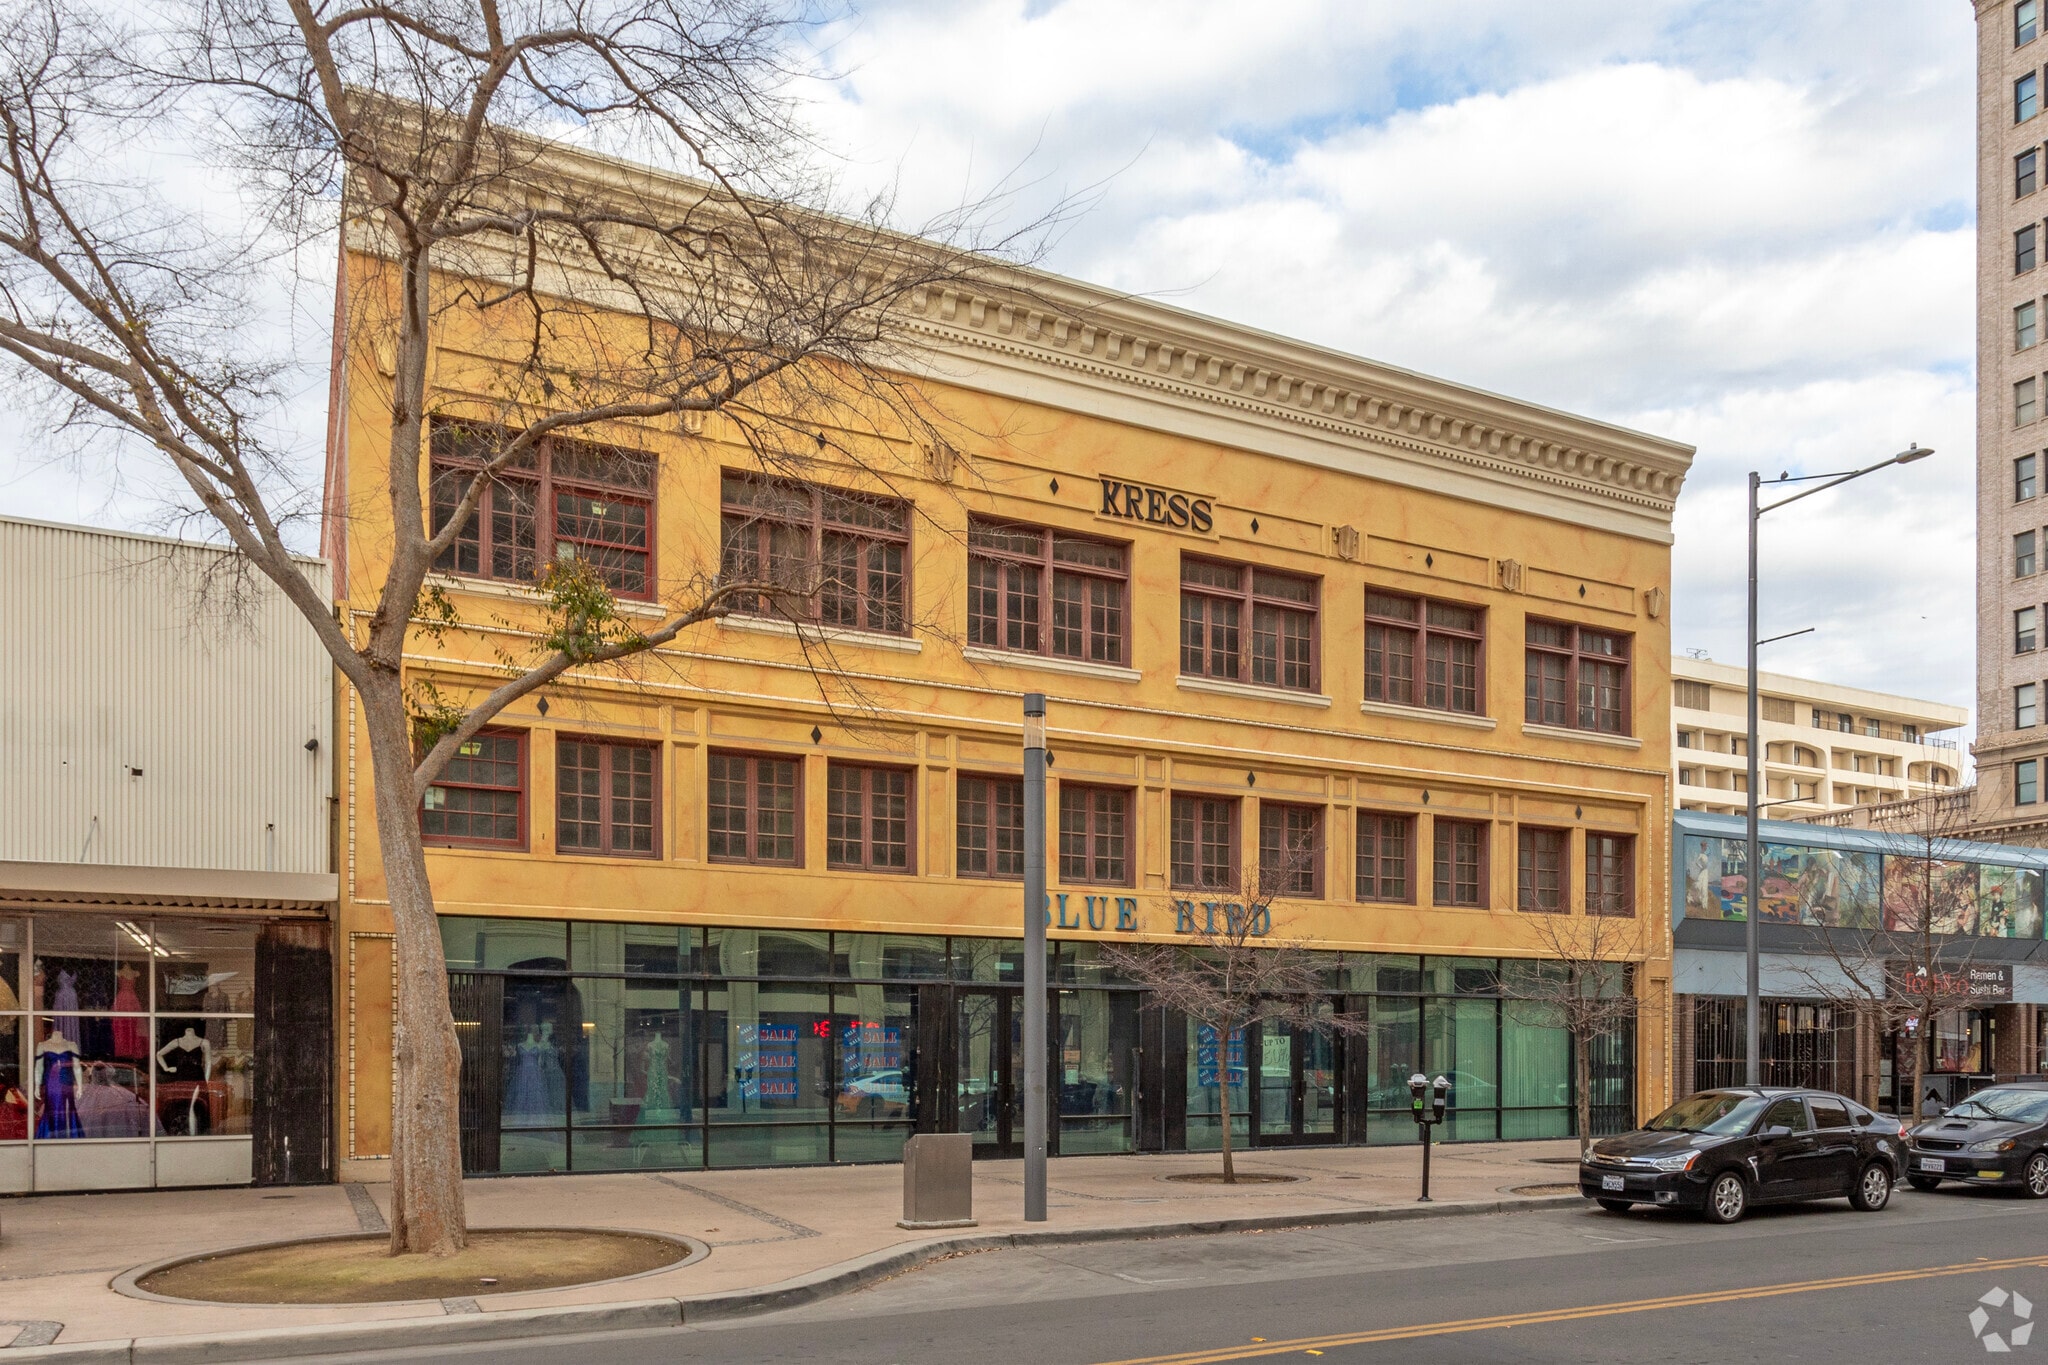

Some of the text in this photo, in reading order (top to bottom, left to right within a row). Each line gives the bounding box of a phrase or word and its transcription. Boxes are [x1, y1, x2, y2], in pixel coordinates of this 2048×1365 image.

[1100, 479, 1213, 532] KRESS
[1046, 893, 1271, 937] LUE BIRD
[1970, 969, 2004, 981] Ramen &
[1992, 984, 2006, 995] Bar
[760, 1029, 797, 1041] SALE
[863, 1032, 897, 1044] SALE
[1214, 1030, 1242, 1041] SLE
[1264, 1037, 1286, 1047] UP TO
[759, 1055, 796, 1068] SALE
[863, 1056, 898, 1068] SALE
[1214, 1051, 1242, 1062] SLE
[1214, 1072, 1241, 1083] SLE
[760, 1082, 797, 1095] SALE
